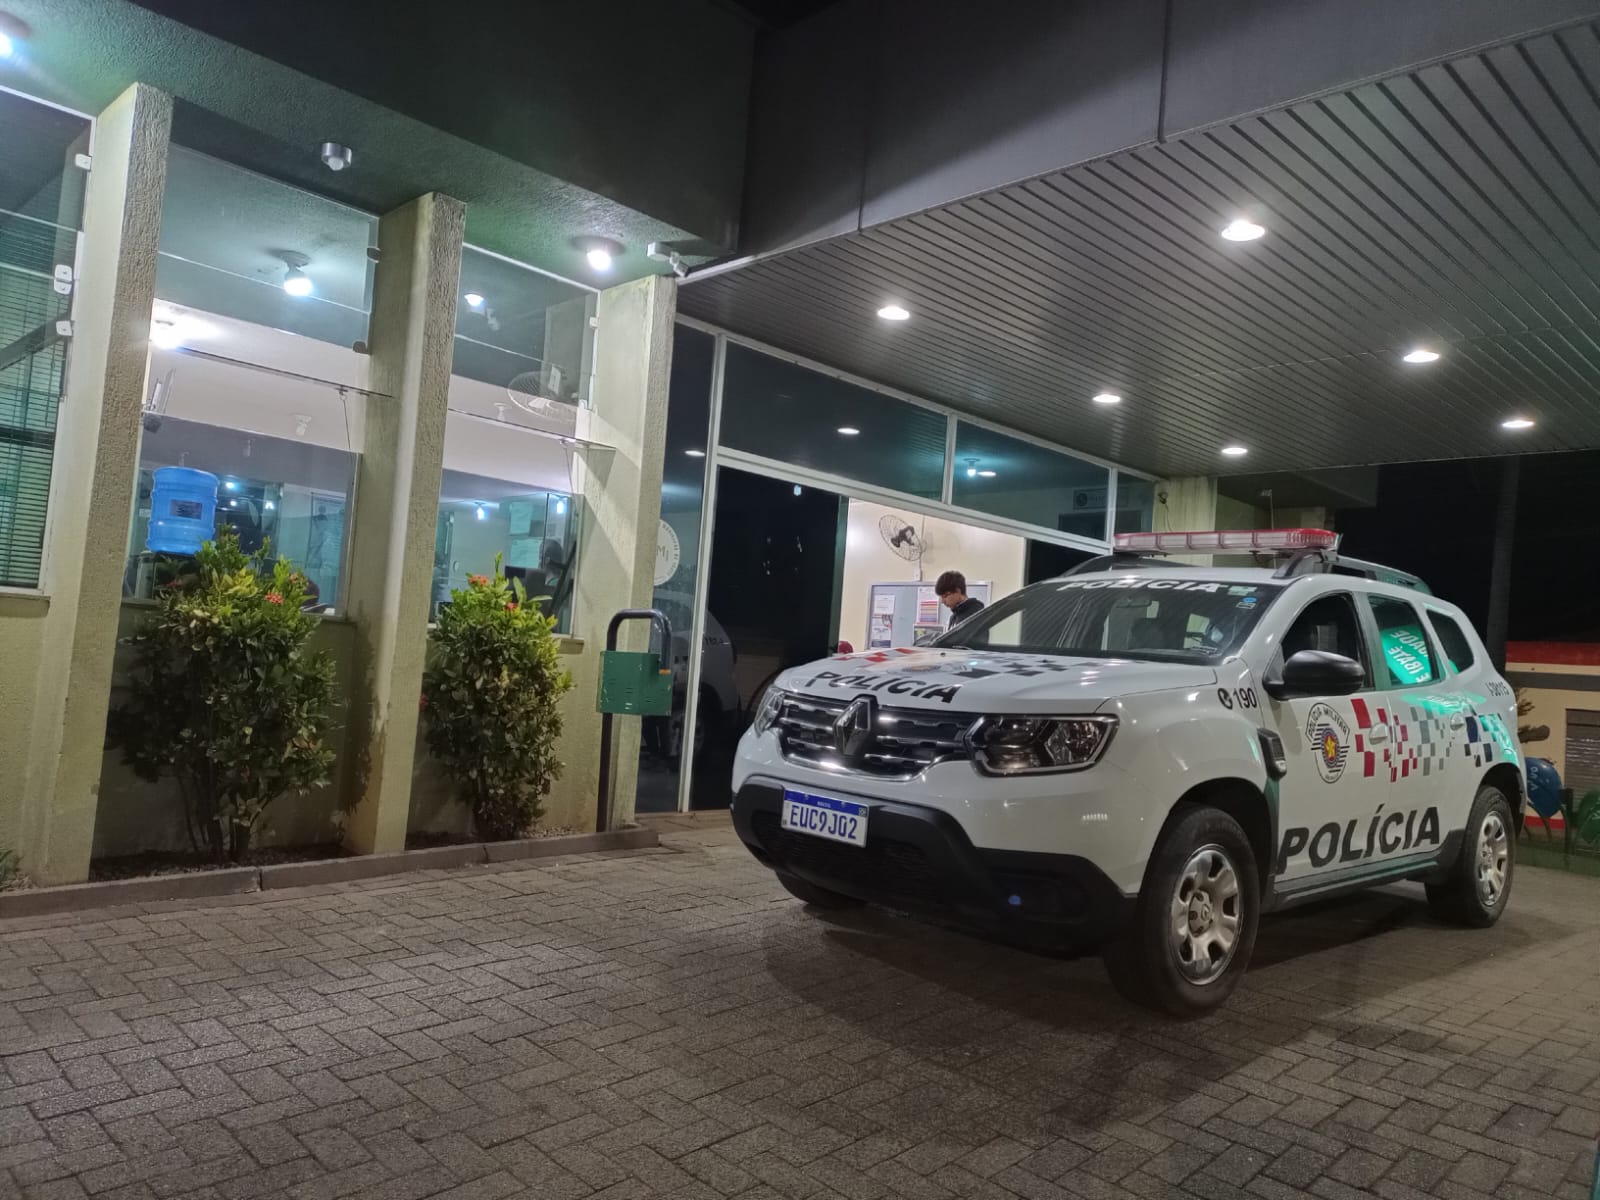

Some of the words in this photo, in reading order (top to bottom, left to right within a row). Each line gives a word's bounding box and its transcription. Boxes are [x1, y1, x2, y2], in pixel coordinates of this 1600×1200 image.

[805, 671, 961, 703] POLÍCIA
[1233, 687, 1257, 709] 190
[790, 804, 858, 840] EUC9J02
[1275, 803, 1440, 875] POLÍCIA
